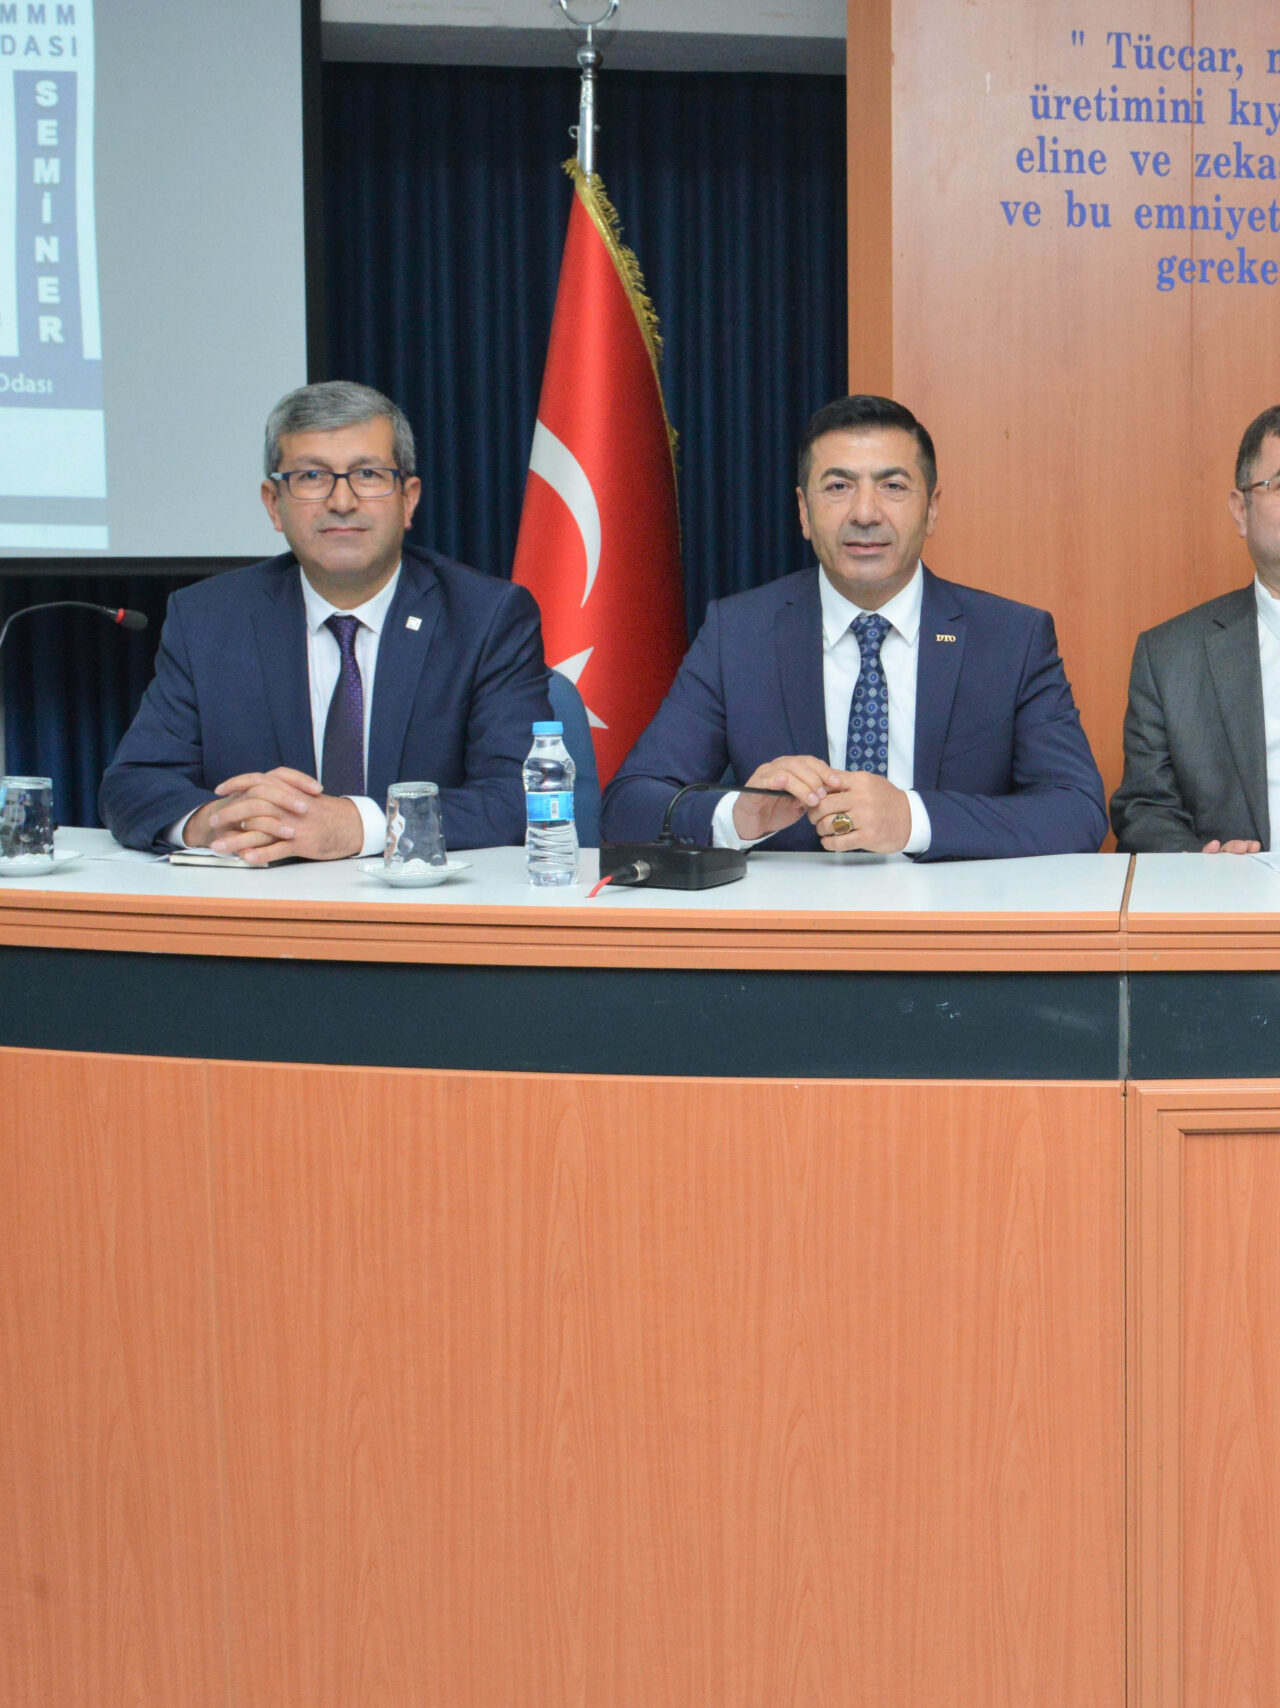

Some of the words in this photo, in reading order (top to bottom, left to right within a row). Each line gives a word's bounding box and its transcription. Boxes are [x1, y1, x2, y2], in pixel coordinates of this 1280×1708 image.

[1106, 31, 1244, 80] Tüccar,
[1029, 84, 1206, 125] üretimini
[1015, 136, 1107, 176] eline
[1131, 151, 1171, 177] ve
[1000, 200, 1041, 226] ve
[1066, 190, 1111, 229] bu
[936, 633, 956, 643] DTO
